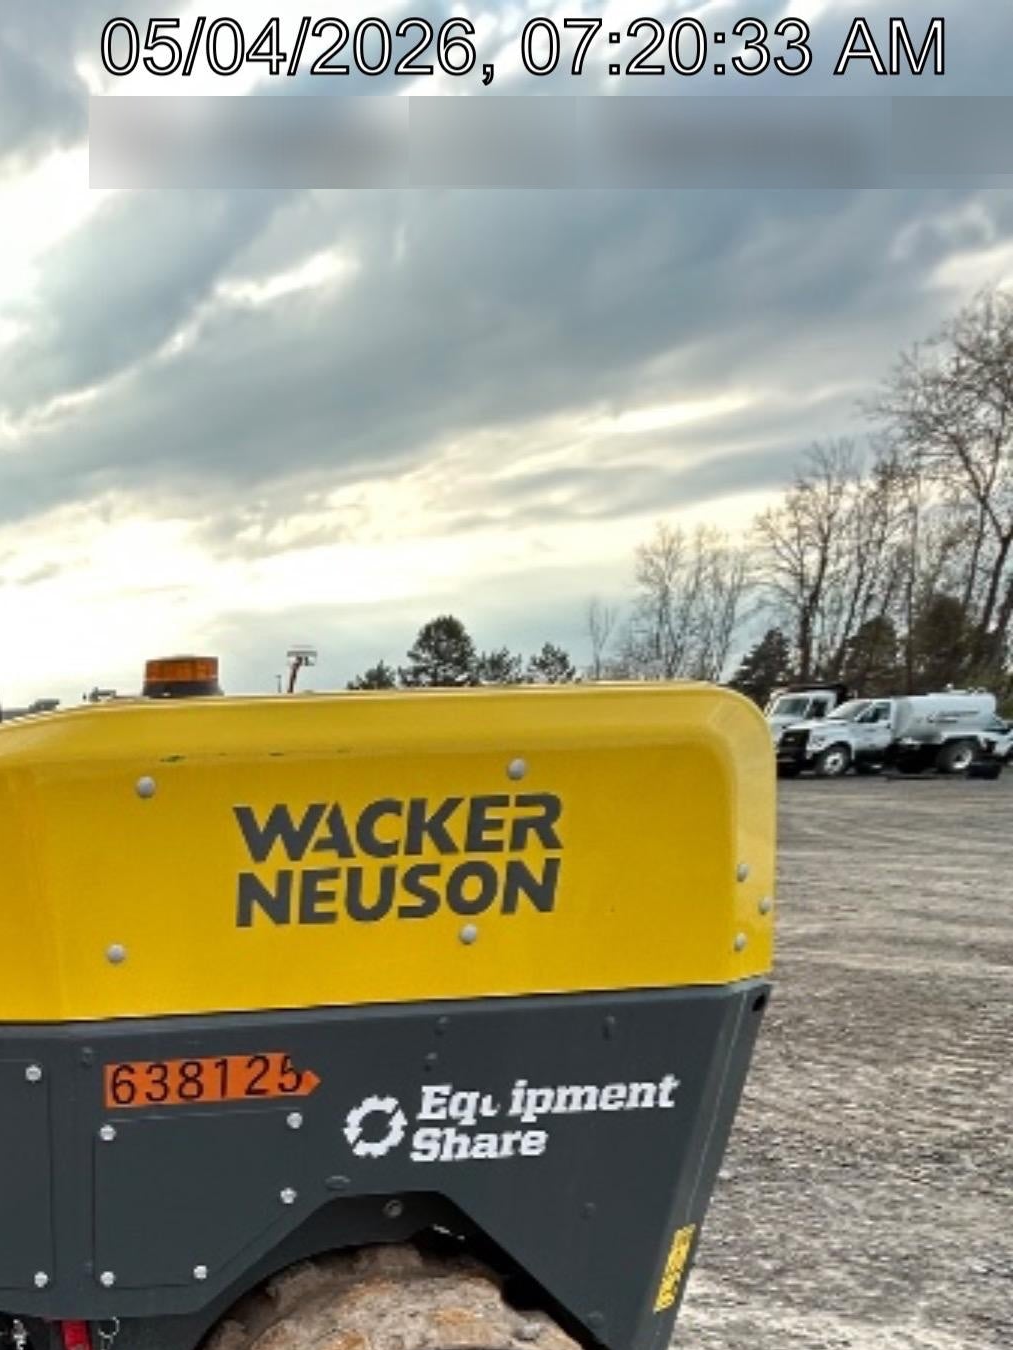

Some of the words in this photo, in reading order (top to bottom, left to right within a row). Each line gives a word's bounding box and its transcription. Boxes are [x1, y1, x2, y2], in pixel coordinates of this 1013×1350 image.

[232, 793, 564, 863] WACKER
[235, 857, 561, 928] NEUSON
[111, 1055, 303, 1104] 638125
[410, 1126, 549, 1162] Share
